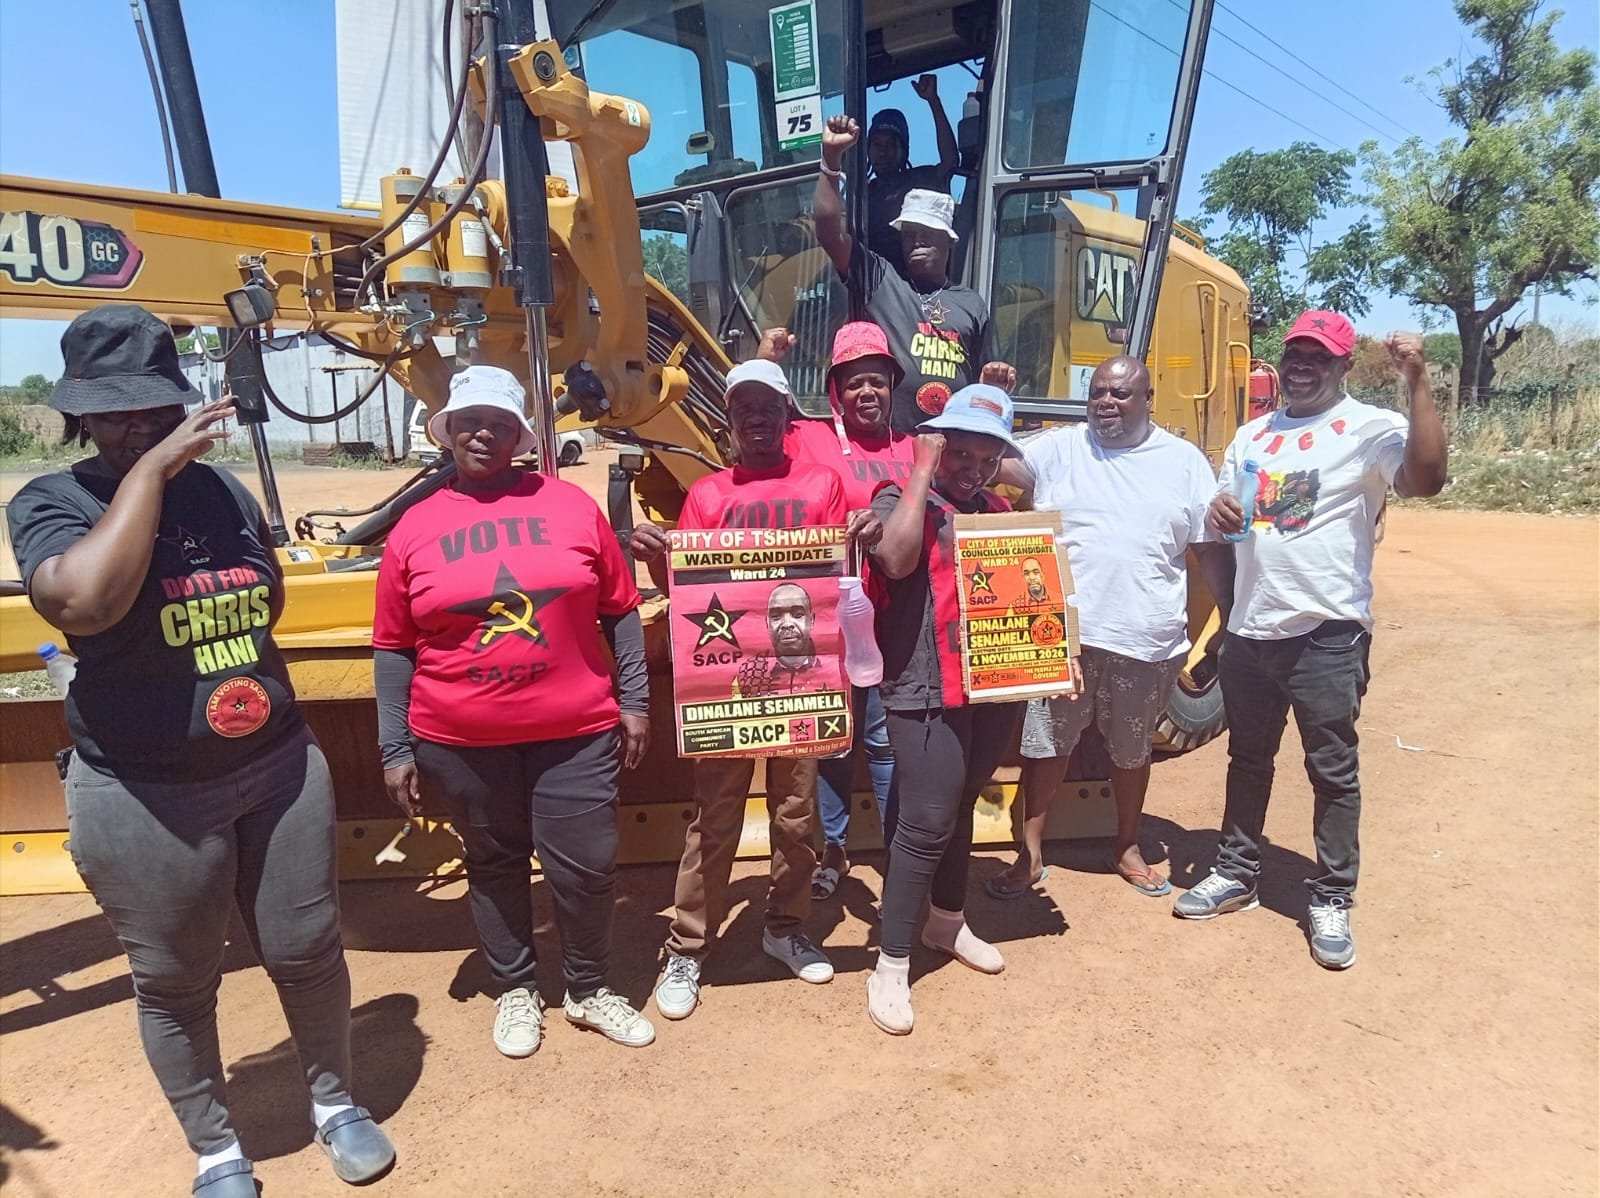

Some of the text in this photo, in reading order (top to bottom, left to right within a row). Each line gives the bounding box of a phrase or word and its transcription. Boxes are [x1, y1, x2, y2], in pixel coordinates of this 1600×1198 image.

[790, 106, 802, 114] LOT
[787, 114, 812, 135] 75
[0, 211, 85, 282] 40
[91, 241, 119, 262] GC
[1078, 248, 1128, 322] CAT
[921, 360, 957, 379] HANI
[438, 516, 552, 564] VOTE
[671, 528, 846, 549] CITY OF TSHWANE
[967, 536, 1044, 549] CITY OF TSHWANE
[685, 548, 833, 566] WARD CANDIDATE
[961, 546, 1053, 557] COUNCILLOR CANDIDATE
[769, 567, 786, 579] 24
[982, 558, 1019, 568] WARD 24
[217, 565, 259, 589] FOR
[969, 595, 998, 605] SACP
[160, 585, 270, 647] CHRIS
[970, 616, 1029, 632] DINALANE
[970, 630, 1031, 647] SENAMELA
[194, 634, 259, 674] HANI
[693, 651, 744, 667] SACP
[972, 656, 979, 665] 4
[981, 651, 1037, 664] NOVEMBER
[1038, 649, 1064, 660] 2026
[465, 662, 549, 682] SACP
[216, 680, 249, 695] VOTING
[249, 682, 266, 701] SACP
[686, 694, 843, 721] DINALANE SENAMELA
[739, 724, 785, 745] SACP
